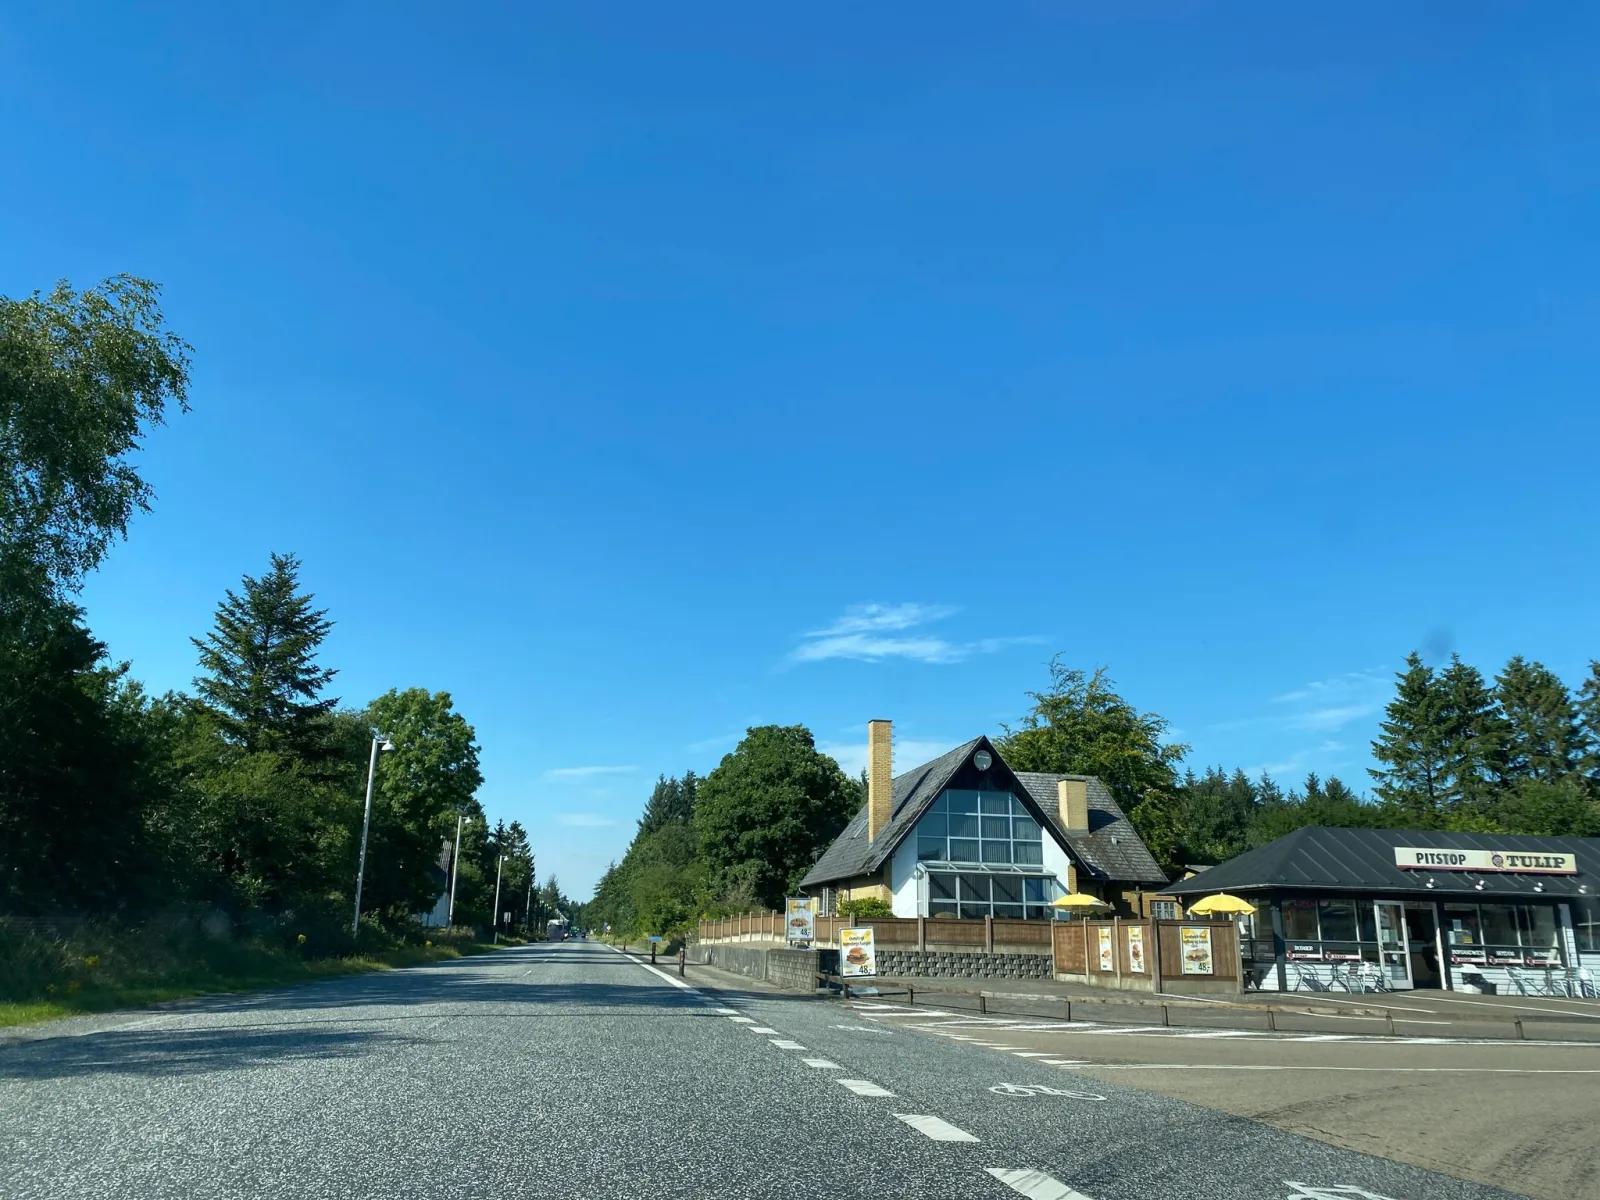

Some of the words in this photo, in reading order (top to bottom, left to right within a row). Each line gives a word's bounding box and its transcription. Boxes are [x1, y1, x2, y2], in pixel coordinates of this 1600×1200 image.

[1415, 852, 1467, 866] PITSTOP
[1506, 855, 1566, 869] TULIP
[859, 965, 873, 975] 48,-
[1198, 963, 1210, 973] 48,-
